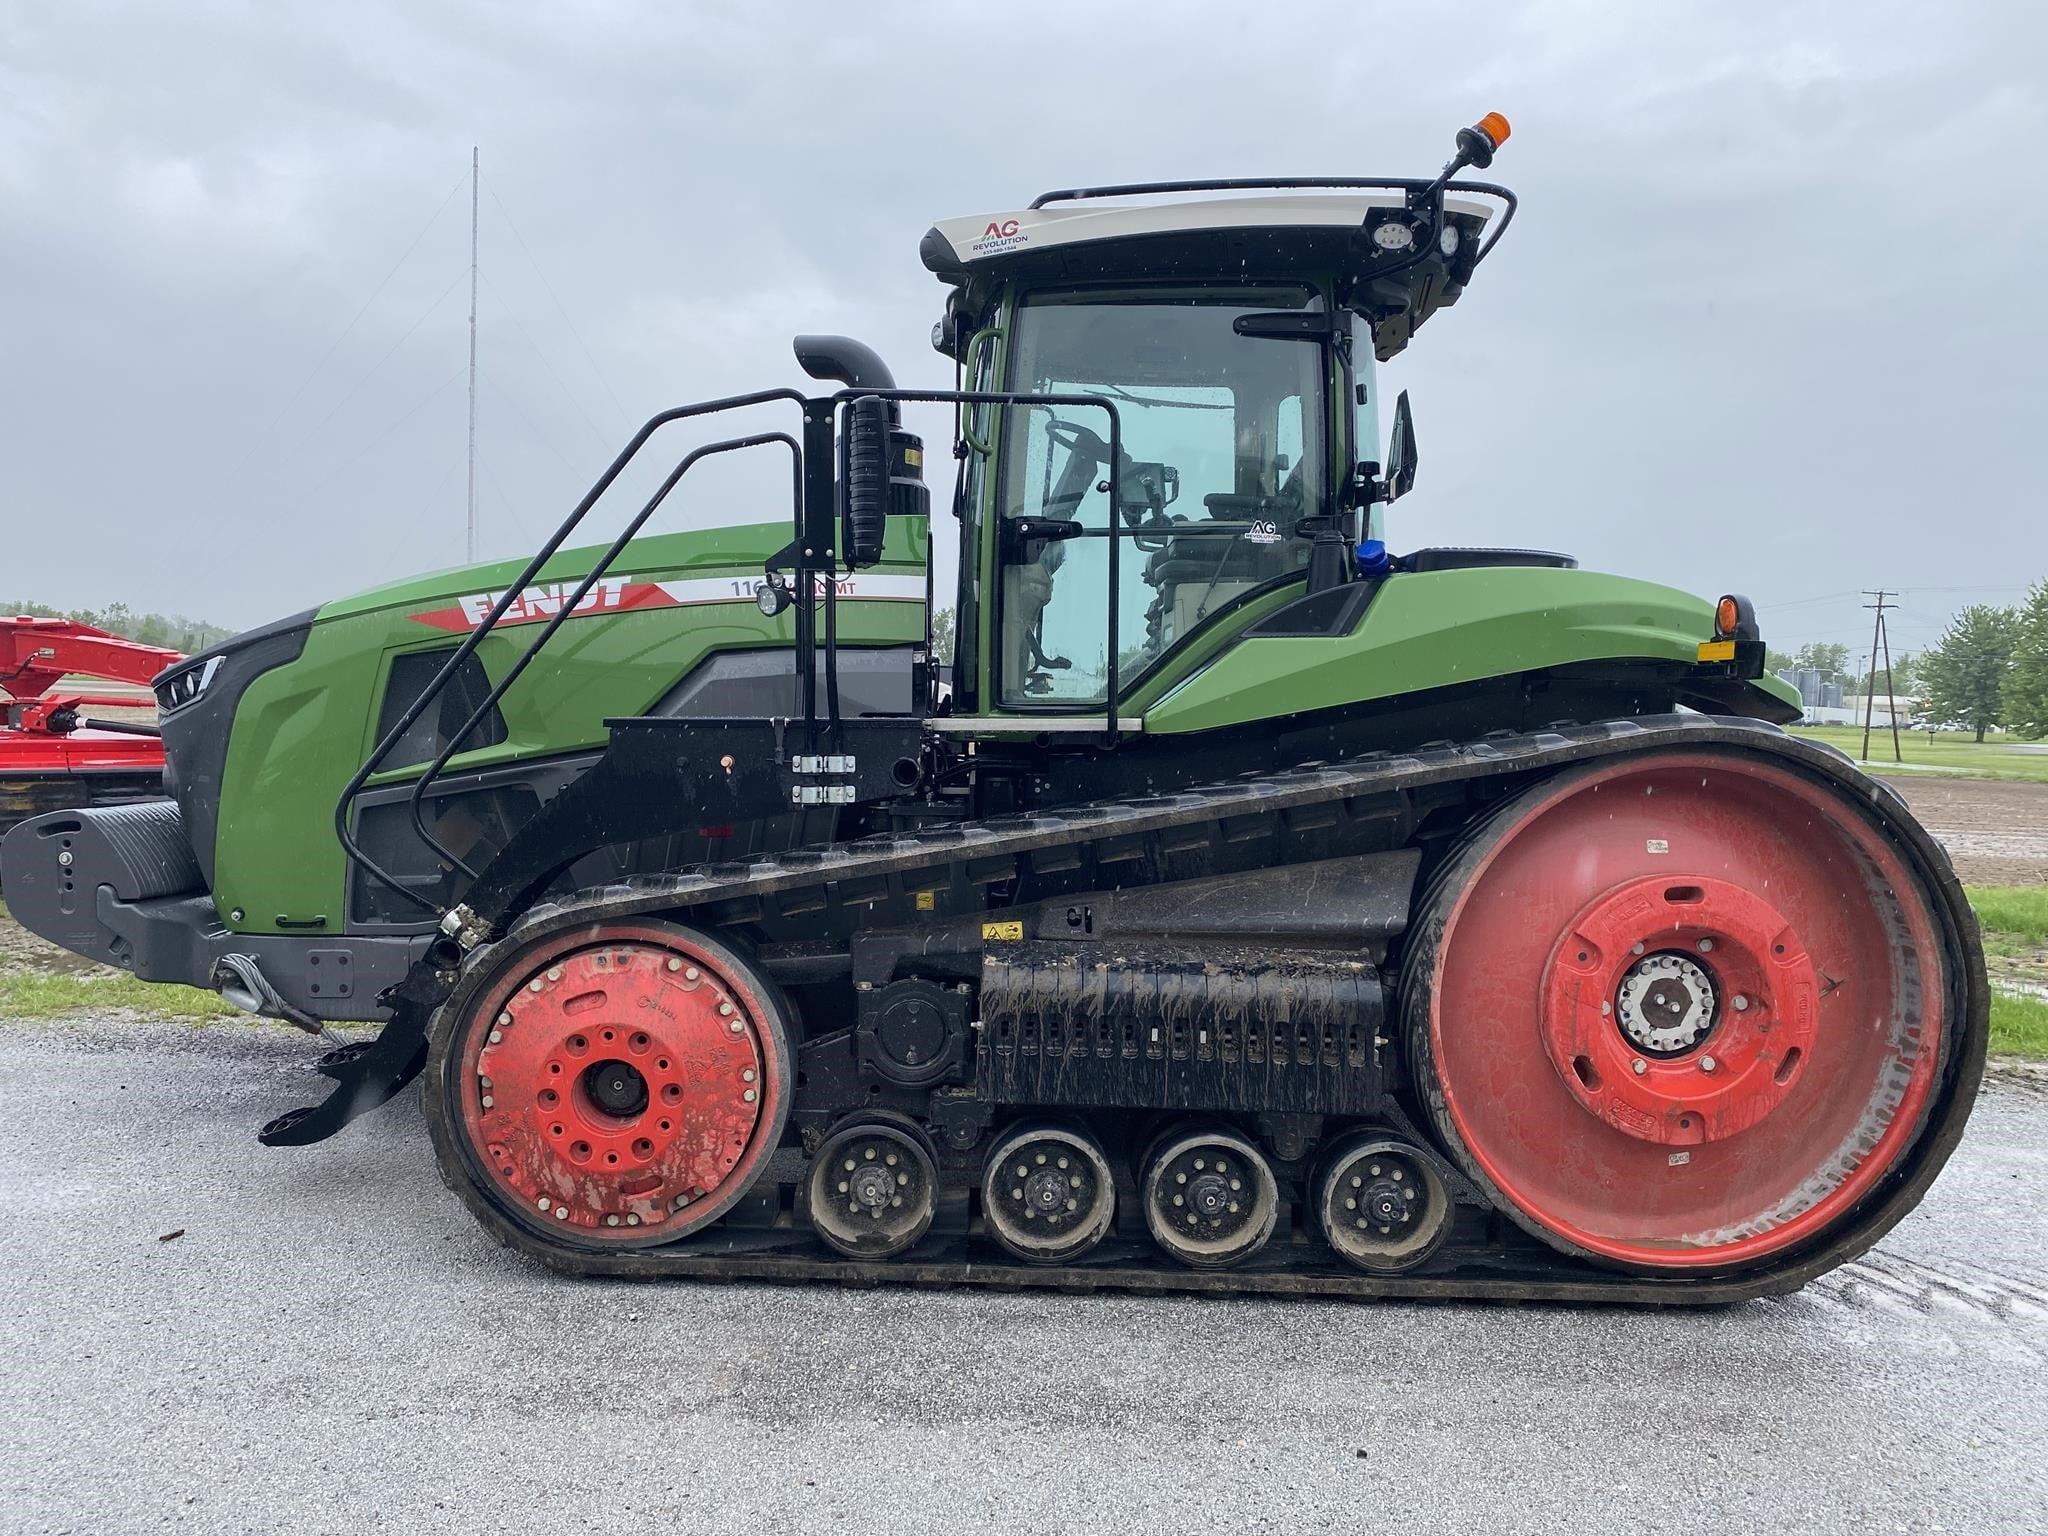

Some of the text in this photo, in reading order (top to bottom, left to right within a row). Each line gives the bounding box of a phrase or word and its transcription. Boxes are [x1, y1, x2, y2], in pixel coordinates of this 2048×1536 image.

[983, 219, 1020, 239] AG
[973, 235, 1028, 251] REVOLUTION
[1252, 521, 1276, 534] AG
[458, 575, 632, 624] FENDT
